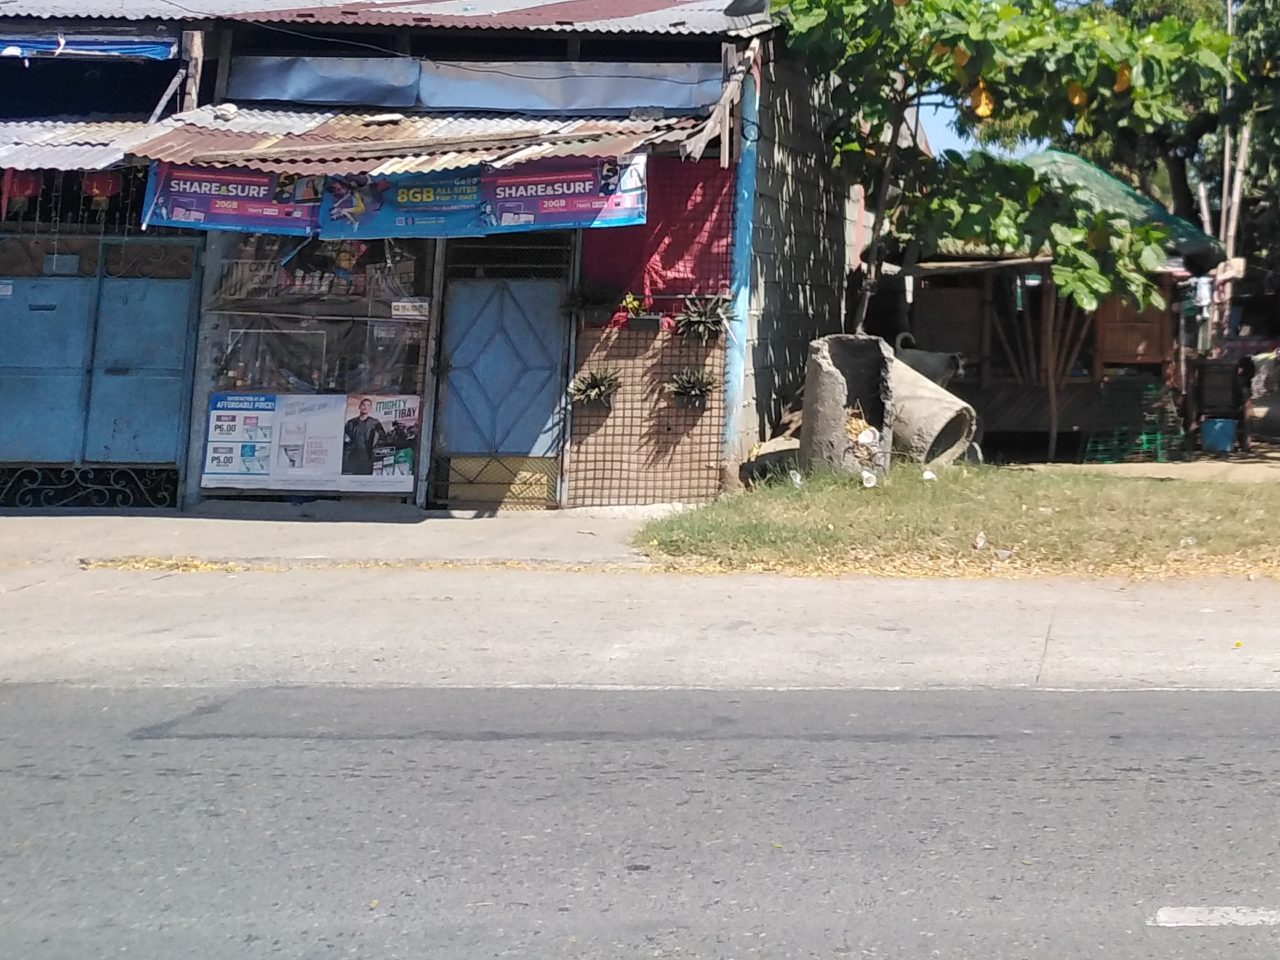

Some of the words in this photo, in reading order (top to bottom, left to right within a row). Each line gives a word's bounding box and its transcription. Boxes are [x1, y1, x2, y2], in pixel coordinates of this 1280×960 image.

[170, 180, 269, 198] SHARE&SURF
[495, 180, 594, 199] SHARE&SURF
[397, 188, 434, 202] 8GB
[215, 200, 239, 209] 20GB
[543, 199, 566, 208] 20GB
[217, 401, 253, 409] AFFORDABLE
[375, 399, 409, 413] MIGHTY
[394, 407, 417, 420] TIBAY
[214, 424, 237, 432] P6.00
[211, 456, 234, 464] P5.00
